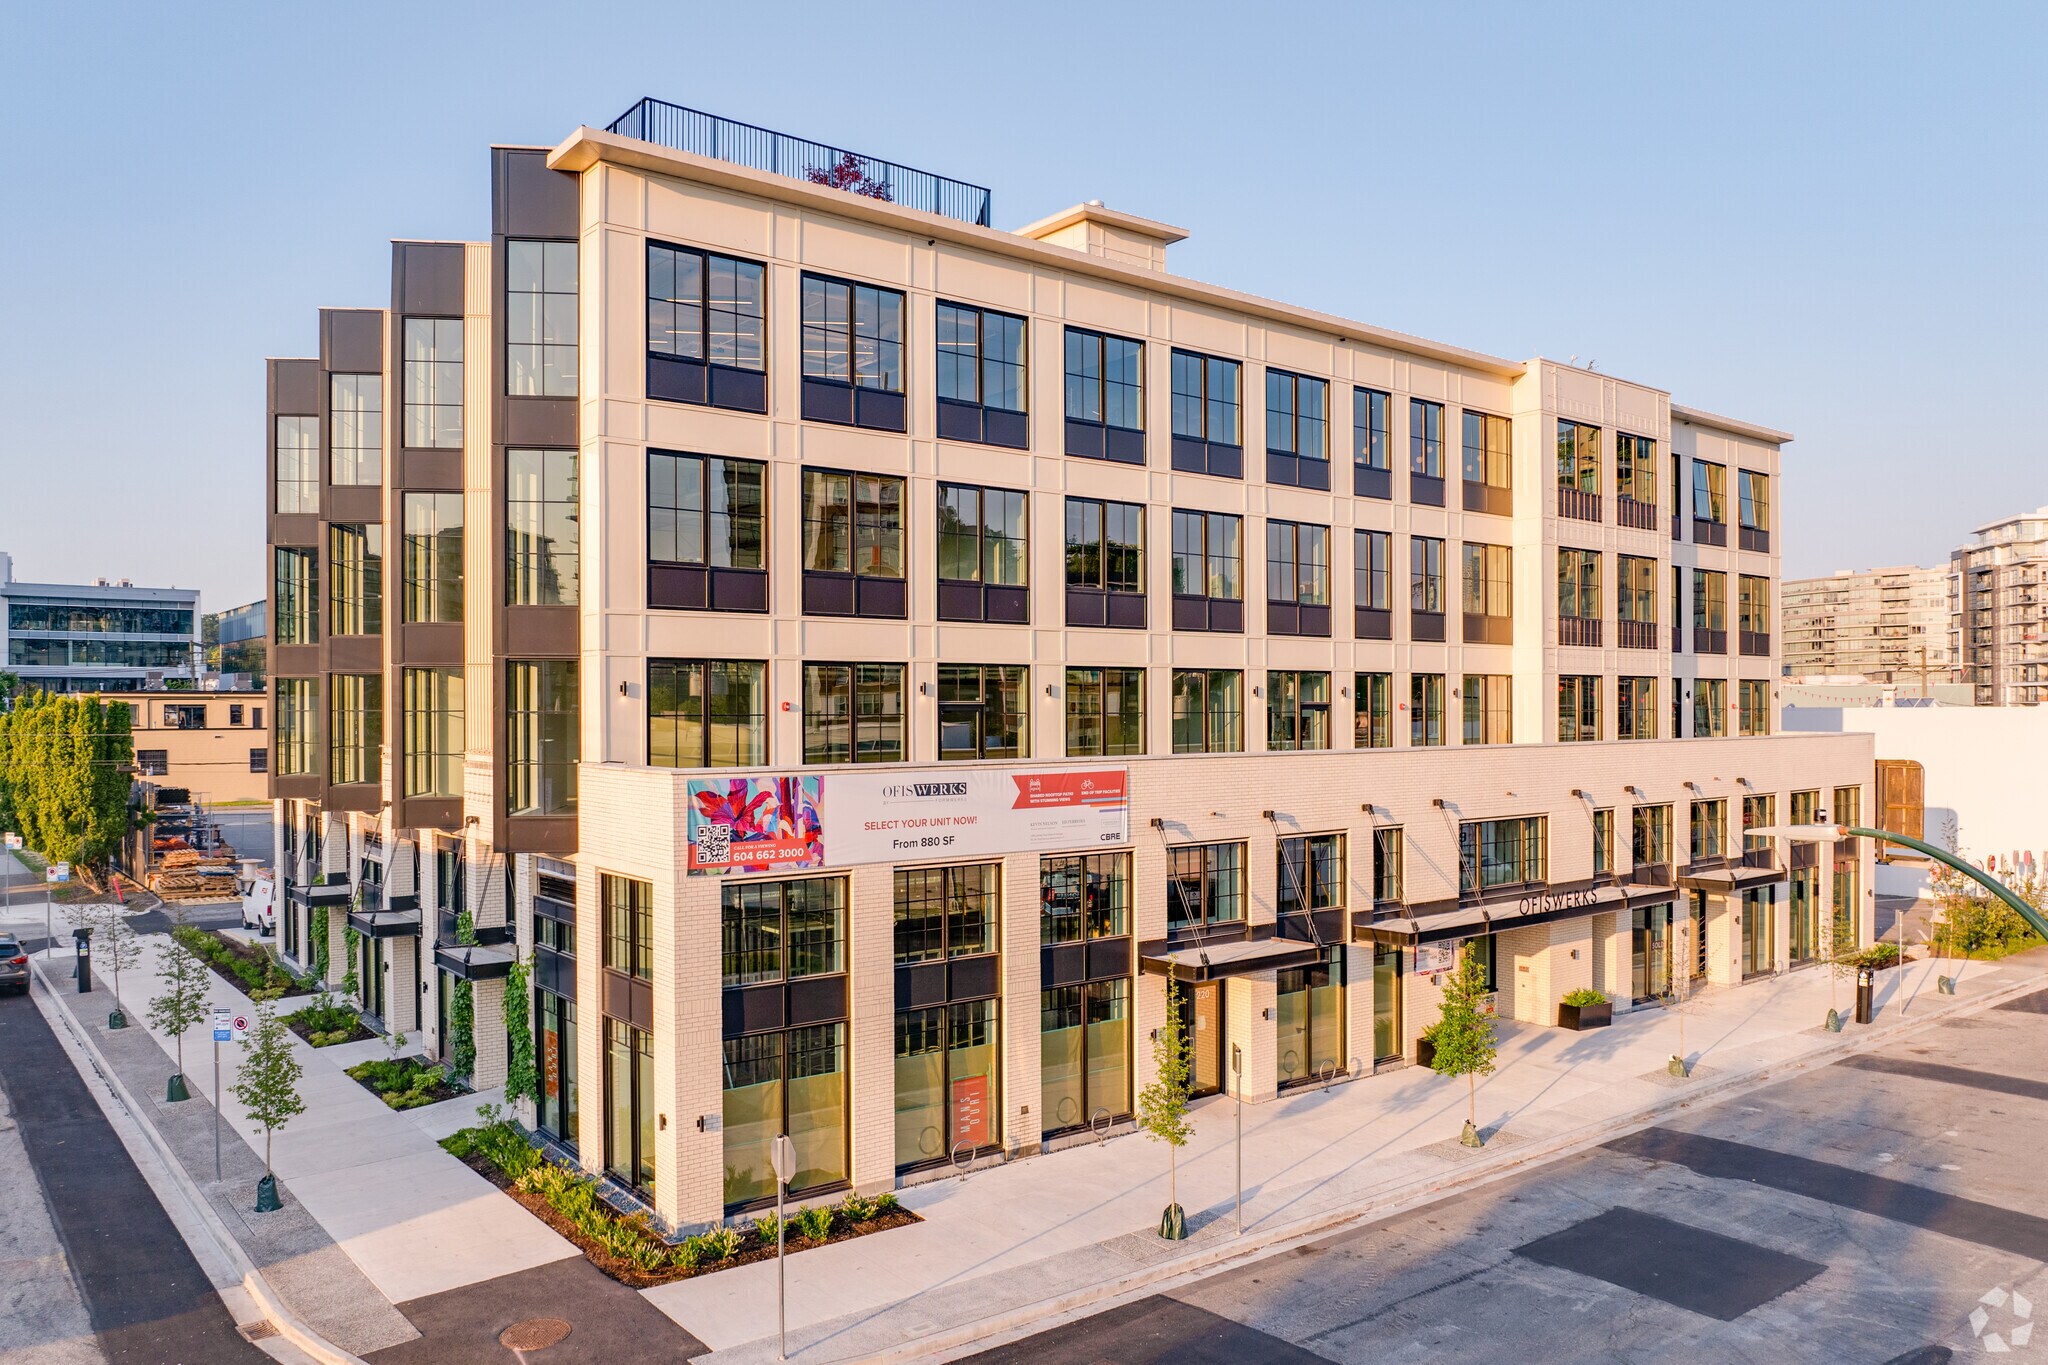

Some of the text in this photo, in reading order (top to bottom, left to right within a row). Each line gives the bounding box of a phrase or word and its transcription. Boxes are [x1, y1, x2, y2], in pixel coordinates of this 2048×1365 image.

[882, 782, 967, 797] OFISWERKS
[864, 815, 977, 831] SELECT YOUR UNIT NOW!
[893, 835, 955, 849] From 880 SF
[1100, 833, 1121, 841] CBRE
[733, 847, 804, 861] 604 662 3000
[1519, 887, 1597, 915] OFISWERKS
[1196, 990, 1210, 1000] 220
